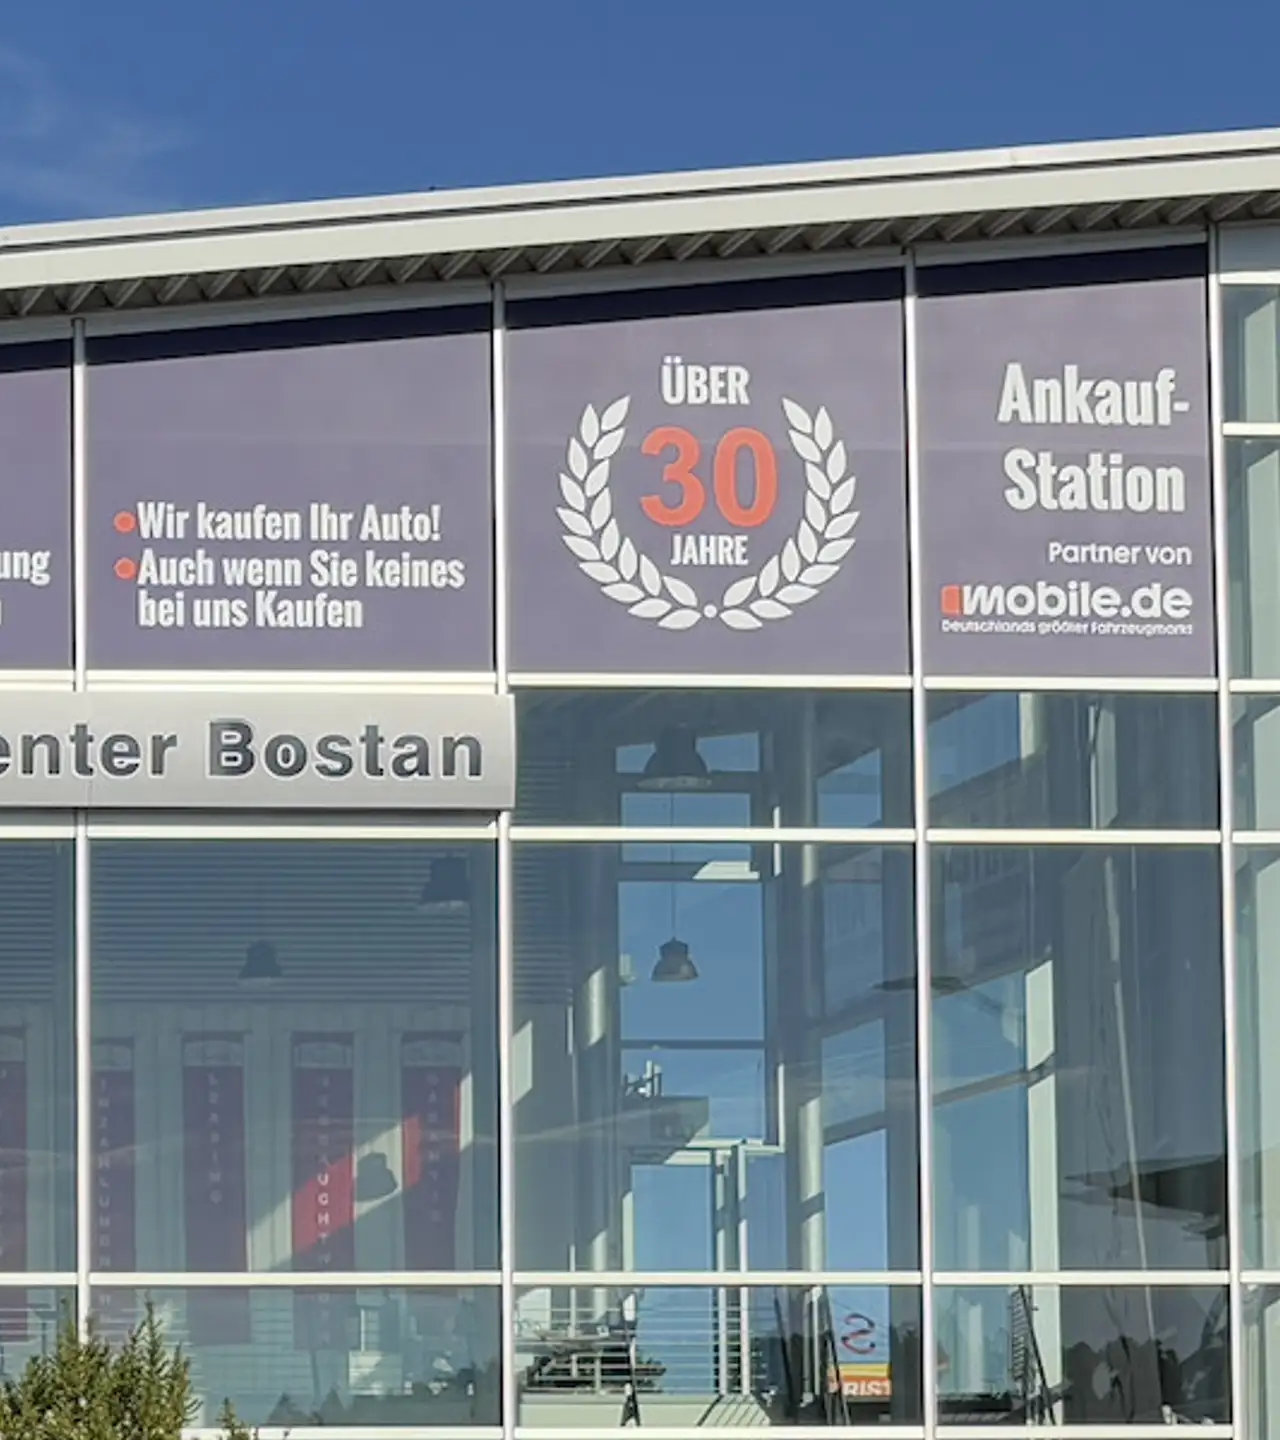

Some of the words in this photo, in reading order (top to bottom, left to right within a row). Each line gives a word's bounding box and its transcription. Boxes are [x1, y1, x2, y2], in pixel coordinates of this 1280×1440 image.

[661, 355, 750, 405] ÜBER
[997, 362, 1190, 426] Ankauf-
[639, 426, 778, 528] 30
[1003, 448, 1186, 512] Station
[138, 502, 190, 540] Wir
[197, 502, 302, 541] kaufen
[310, 503, 354, 541] Ihr
[360, 503, 441, 542] Auto!
[138, 548, 215, 586] Auch
[222, 558, 303, 587] wenn
[310, 550, 358, 587] Sie
[365, 550, 466, 589] keines
[670, 534, 749, 566] JAHRE
[1048, 541, 1139, 565] Partner
[1144, 546, 1193, 565] von
[138, 590, 185, 627] bei
[193, 599, 249, 628] uns
[255, 591, 363, 628] Kaufen
[958, 581, 1193, 619] mobile.de
[941, 618, 1037, 634] Deutschlands
[208, 719, 484, 780] Bostan
